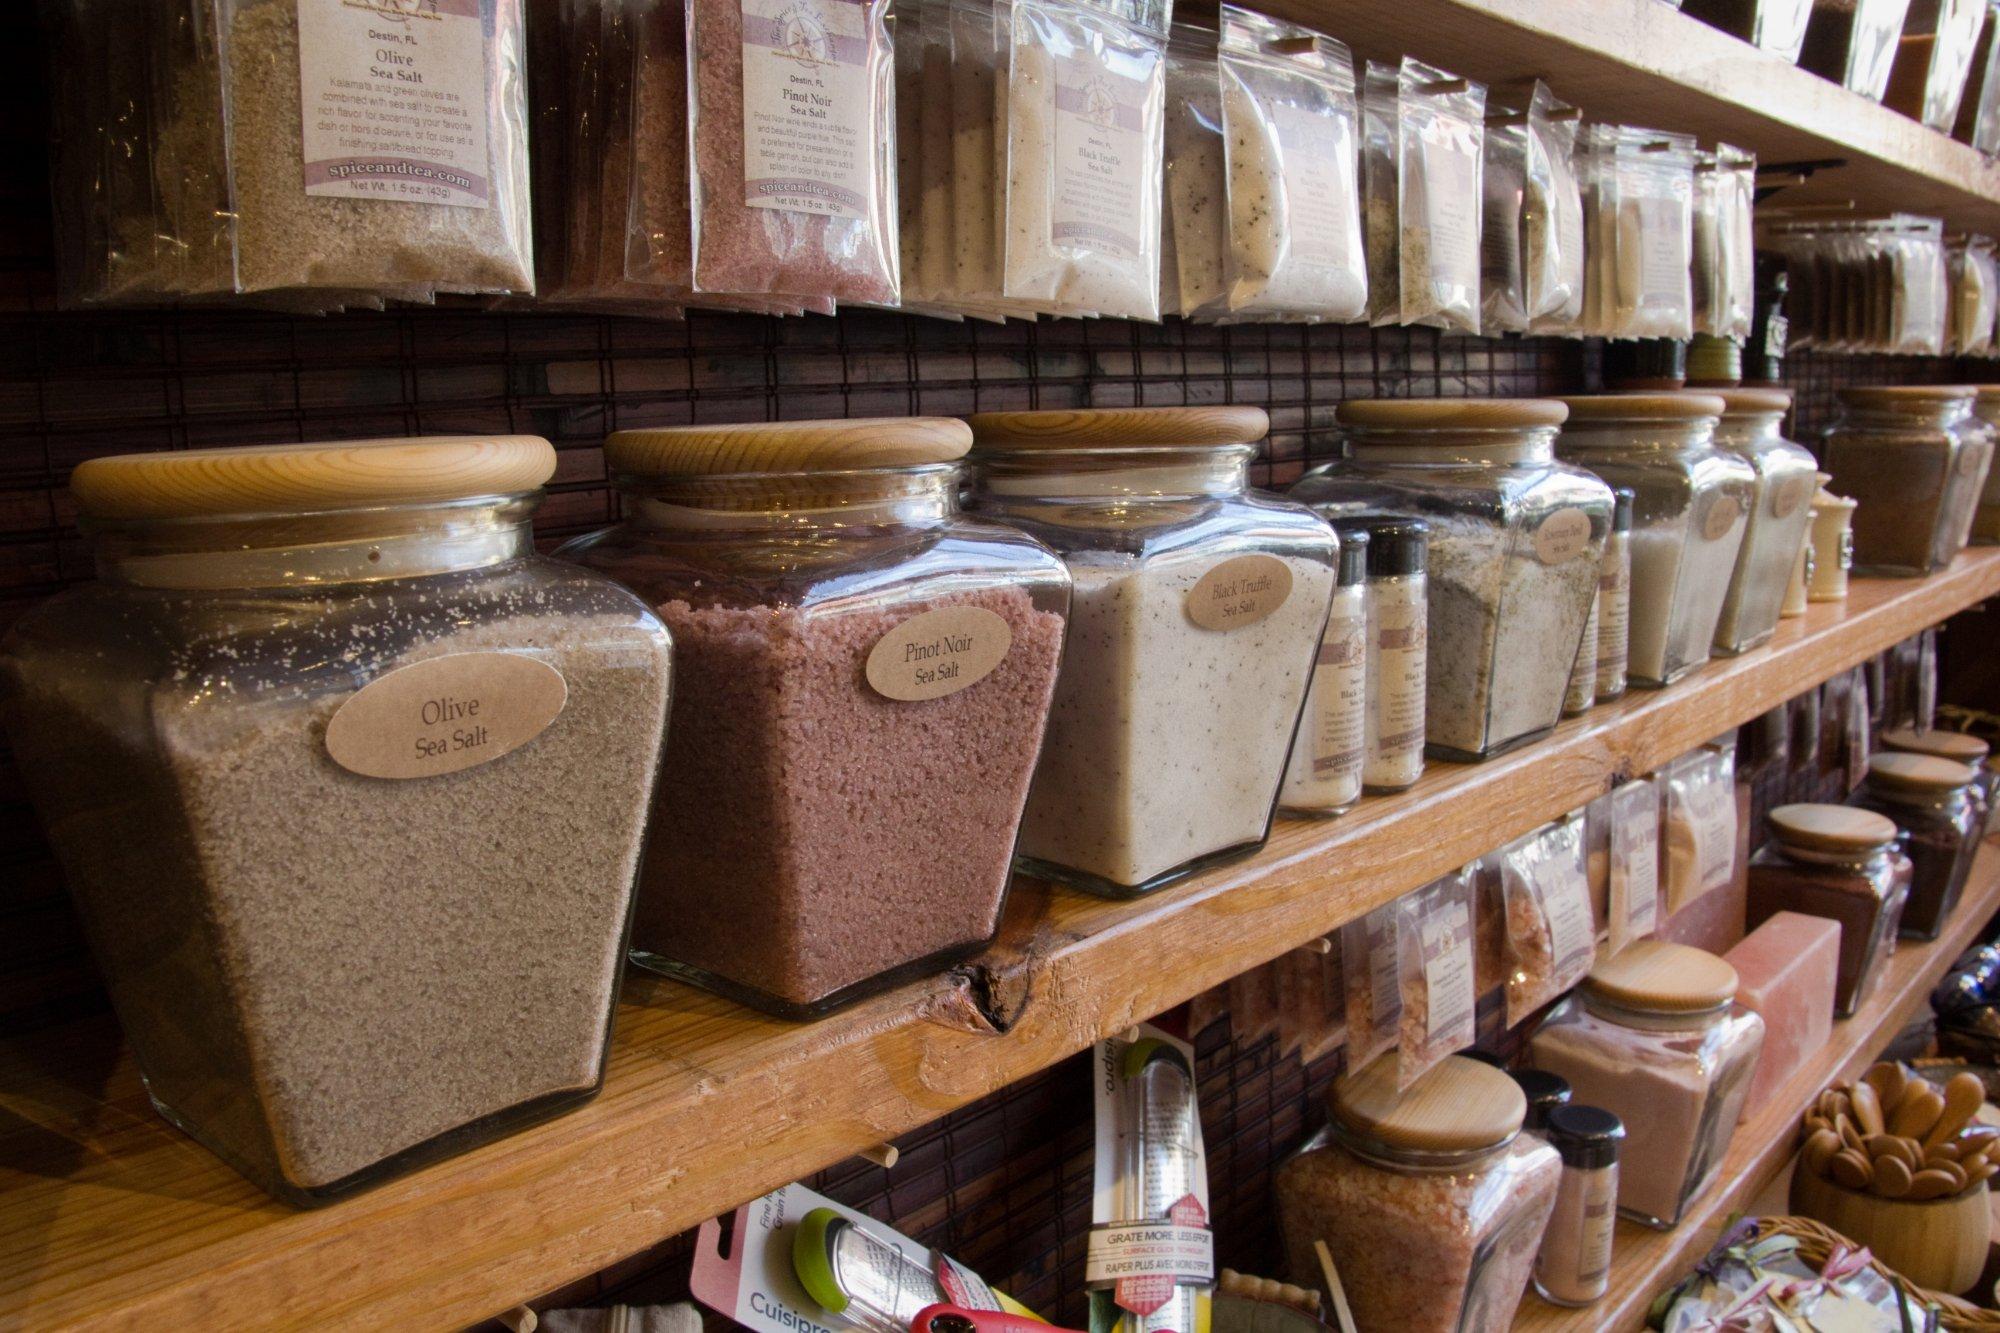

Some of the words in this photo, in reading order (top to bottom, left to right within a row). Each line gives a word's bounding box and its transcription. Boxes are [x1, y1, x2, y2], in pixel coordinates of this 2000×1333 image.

[368, 29, 402, 43] Destin,
[405, 35, 418, 46] FL
[375, 48, 414, 67] Olive
[370, 66, 394, 80] Sea
[397, 70, 423, 84] Salt
[790, 75, 814, 87] Destin,
[815, 78, 825, 88] FL
[330, 79, 372, 91] Kalamata
[375, 83, 391, 93] and
[393, 87, 418, 97] green
[420, 90, 444, 99] olives
[446, 93, 460, 101] are
[782, 88, 808, 103] Pinot
[810, 93, 832, 107] Noir
[322, 93, 367, 105] combined
[370, 97, 387, 106] with
[389, 100, 405, 109] sea
[407, 101, 422, 111] salt
[424, 103, 433, 113] to
[434, 106, 461, 116] create
[790, 104, 807, 115] Sea
[809, 106, 826, 119] Salt
[318, 106, 335, 116] rich
[337, 108, 362, 119] flavor
[365, 111, 377, 120] for
[380, 113, 420, 127] accenting
[422, 118, 441, 128] your
[443, 120, 472, 132] favorite
[754, 111, 771, 121] Pinot
[318, 120, 337, 131] dish
[339, 124, 349, 132] or
[351, 123, 371, 134] hors
[415, 130, 424, 140] or
[426, 131, 438, 141] for
[440, 135, 455, 144] use
[456, 137, 466, 145] as
[758, 126, 770, 134] and
[339, 137, 377, 151] finishing
[767, 138, 796, 150] preferred
[1079, 147, 1098, 160] Black
[1099, 152, 1121, 166] Truffle
[328, 160, 471, 189] spiceandtea.com
[1088, 162, 1099, 172] Sea
[1100, 164, 1113, 176] Salt
[350, 179, 369, 191] Net
[409, 186, 424, 195] oz.
[427, 186, 451, 200] (43g)
[759, 179, 855, 206] spiceandtea.com
[775, 195, 788, 206] Net
[1213, 580, 1238, 601] Black
[1239, 573, 1273, 595] Truffle
[1221, 603, 1238, 618] Sea
[1239, 599, 1256, 614] Salt
[904, 639, 941, 663] Pinot
[943, 632, 974, 656] Noir
[915, 667, 935, 686] Sea
[937, 660, 960, 681] Salt
[422, 697, 480, 726] Olive
[415, 738, 448, 760] Sea
[453, 726, 488, 751] Salt
[760, 1204, 773, 1230] Fine
[773, 1198, 787, 1230] Grain
[1107, 1232, 1144, 1245] GRATE
[1177, 1231, 1192, 1241] LESS
[1105, 1261, 1133, 1274] RAPER
[1134, 1260, 1153, 1271] PLUS
[1156, 1260, 1173, 1270] AVEC
